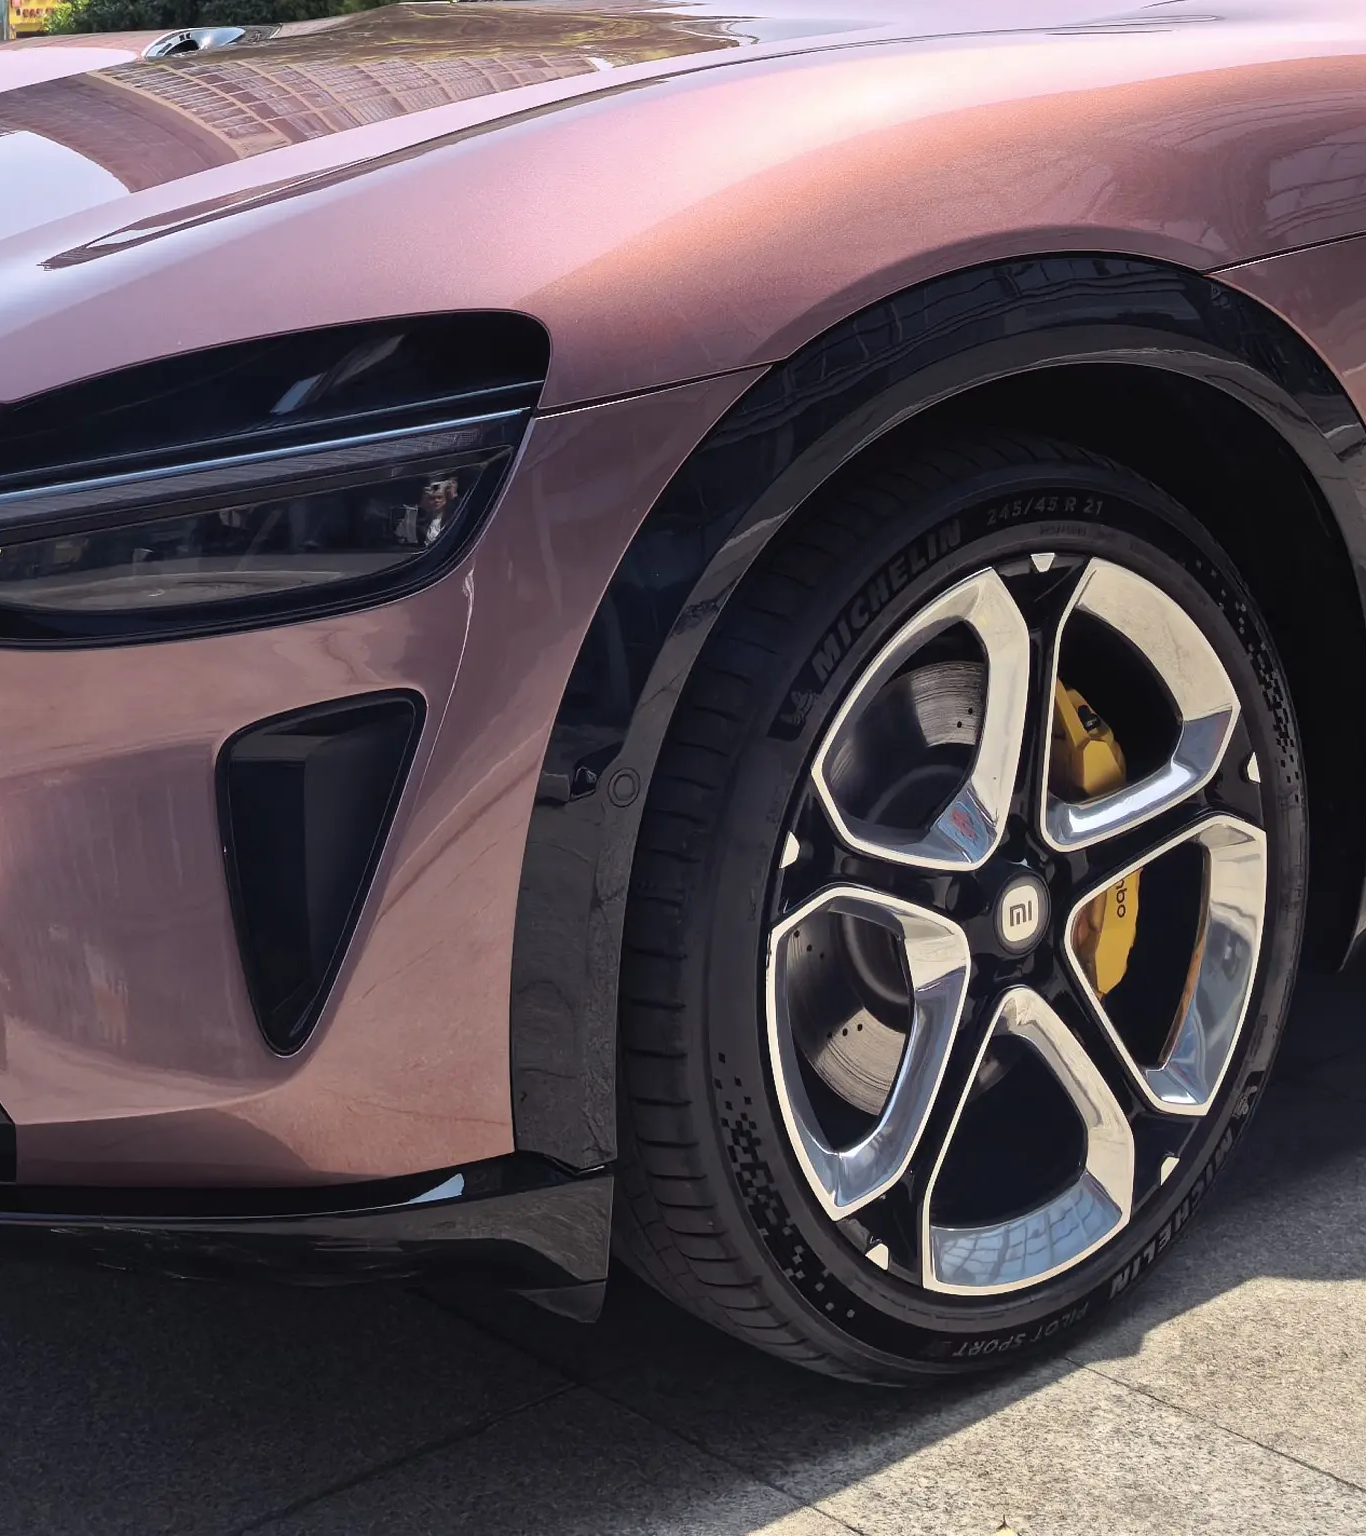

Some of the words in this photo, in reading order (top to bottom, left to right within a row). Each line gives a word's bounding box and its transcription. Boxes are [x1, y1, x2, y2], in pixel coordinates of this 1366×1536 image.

[813, 519, 962, 683] MICHELIN
[1109, 1126, 1233, 1300] MICHELIN
[952, 1332, 1026, 1356] SPORT
[1030, 1302, 1089, 1342] PILOT
